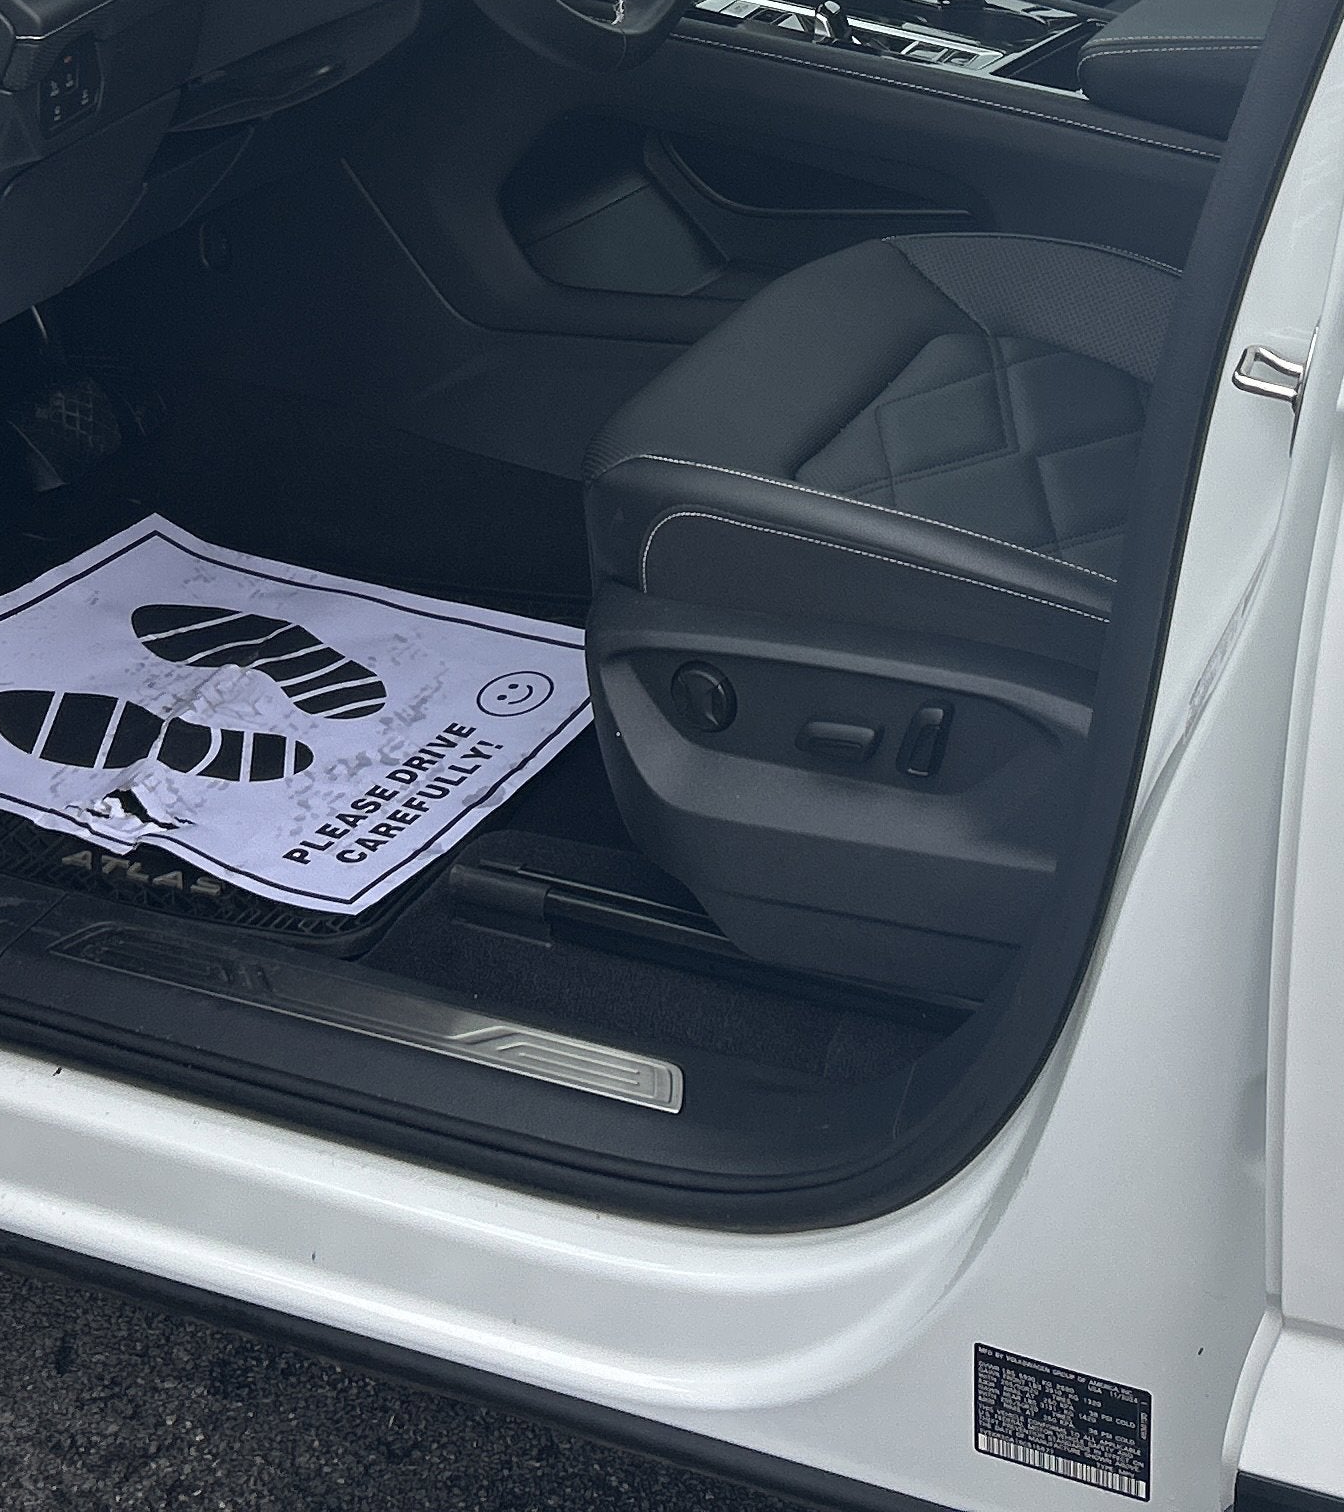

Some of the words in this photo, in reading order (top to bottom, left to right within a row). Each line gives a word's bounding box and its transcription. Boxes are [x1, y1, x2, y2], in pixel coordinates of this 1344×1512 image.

[282, 785, 398, 864] PLEASE
[386, 722, 476, 784] DRIVE
[336, 740, 503, 863] CAREFULLY!
[61, 851, 223, 895] ATLAS
